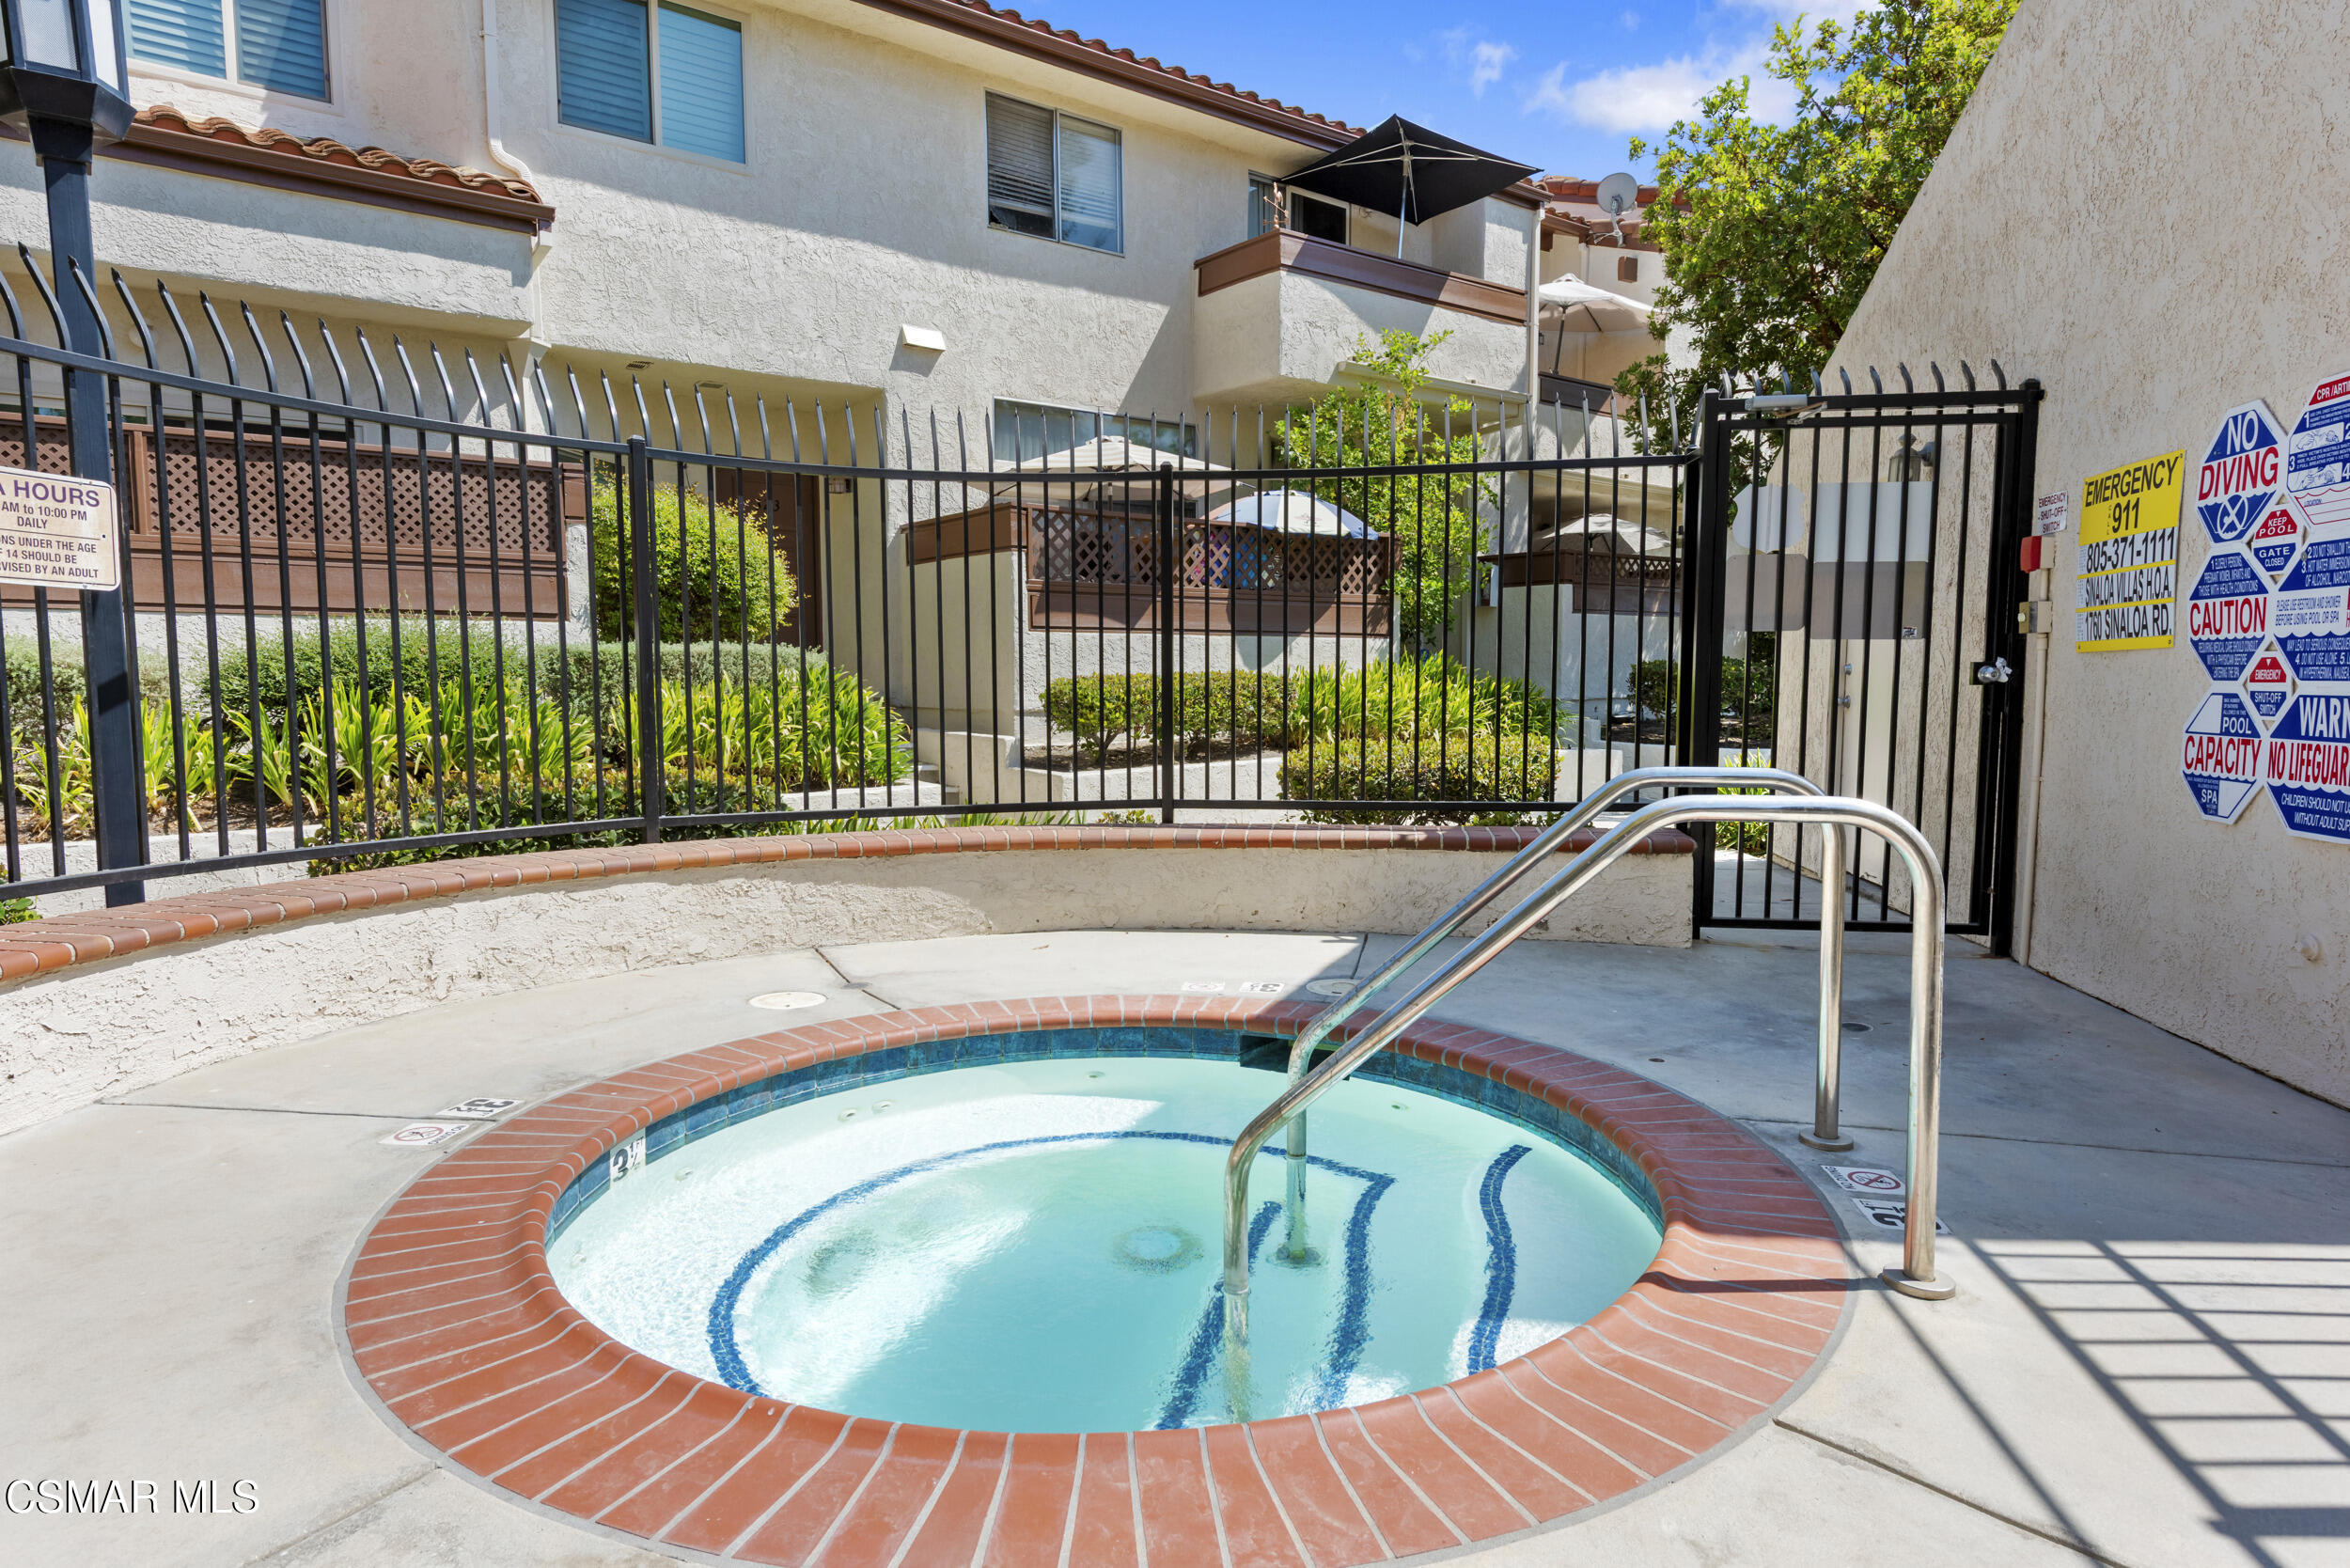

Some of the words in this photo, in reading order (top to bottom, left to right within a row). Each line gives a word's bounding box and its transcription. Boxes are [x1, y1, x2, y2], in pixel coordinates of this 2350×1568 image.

[2316, 386, 2330, 400] CPR
[2304, 412, 2310, 429] 1
[2226, 410, 2259, 455] NO
[2289, 456, 2295, 471] 3
[2085, 456, 2179, 508] EMERGENCY
[2198, 447, 2279, 501] DIVING
[14, 479, 100, 508] HOURS
[2039, 492, 2066, 508] EMERGENCY
[2, 501, 19, 513] AM
[24, 503, 34, 514] to
[39, 506, 68, 519] 10:00
[70, 510, 87, 521] PM
[2112, 497, 2140, 533] 911
[17, 516, 48, 529] DAILY
[2043, 520, 2060, 533] SWITCH
[2268, 516, 2287, 526] KEEP
[2259, 525, 2294, 537] POOL
[0, 534, 15, 545] NS
[19, 537, 53, 549] UNDER
[55, 541, 74, 551] THE
[77, 542, 97, 554] AGE
[2087, 526, 2175, 573] 805-371-1111
[2259, 546, 2291, 557] GATE
[2307, 546, 2312, 558] 2
[7, 549, 18, 559] 14
[22, 550, 61, 563] SHOULD
[65, 555, 77, 564] BE
[2264, 557, 2284, 567] CLOSED
[0, 561, 31, 573] VISED
[35, 564, 48, 574] BY
[52, 566, 65, 576] AN
[69, 567, 98, 578] ADULT
[2086, 573, 2114, 607] SINALOA
[2117, 569, 2144, 604] VILLAS
[2147, 566, 2172, 600] H.O.A.
[2086, 610, 2102, 642] 1760
[2105, 605, 2149, 640] SINALOA
[2153, 603, 2172, 636] RD.
[2189, 597, 2266, 636] CAUTION
[2255, 669, 2281, 680] EMERGENCY
[2255, 693, 2281, 703] SHUT-OFF
[2260, 704, 2276, 714] SWITCH
[2222, 717, 2251, 734] POOL
[2185, 735, 2262, 777] CAPACITY
[2267, 741, 2286, 780] NO
[2288, 743, 2350, 787] LIFEGUAR
[2201, 789, 2217, 804] SPA
[2281, 792, 2308, 808] CHILDREN
[2309, 796, 2331, 810] SHOULD
[2331, 799, 2344, 812] NOT
[2295, 811, 2320, 826] WITHOUT
[2319, 815, 2338, 829] ADULT
